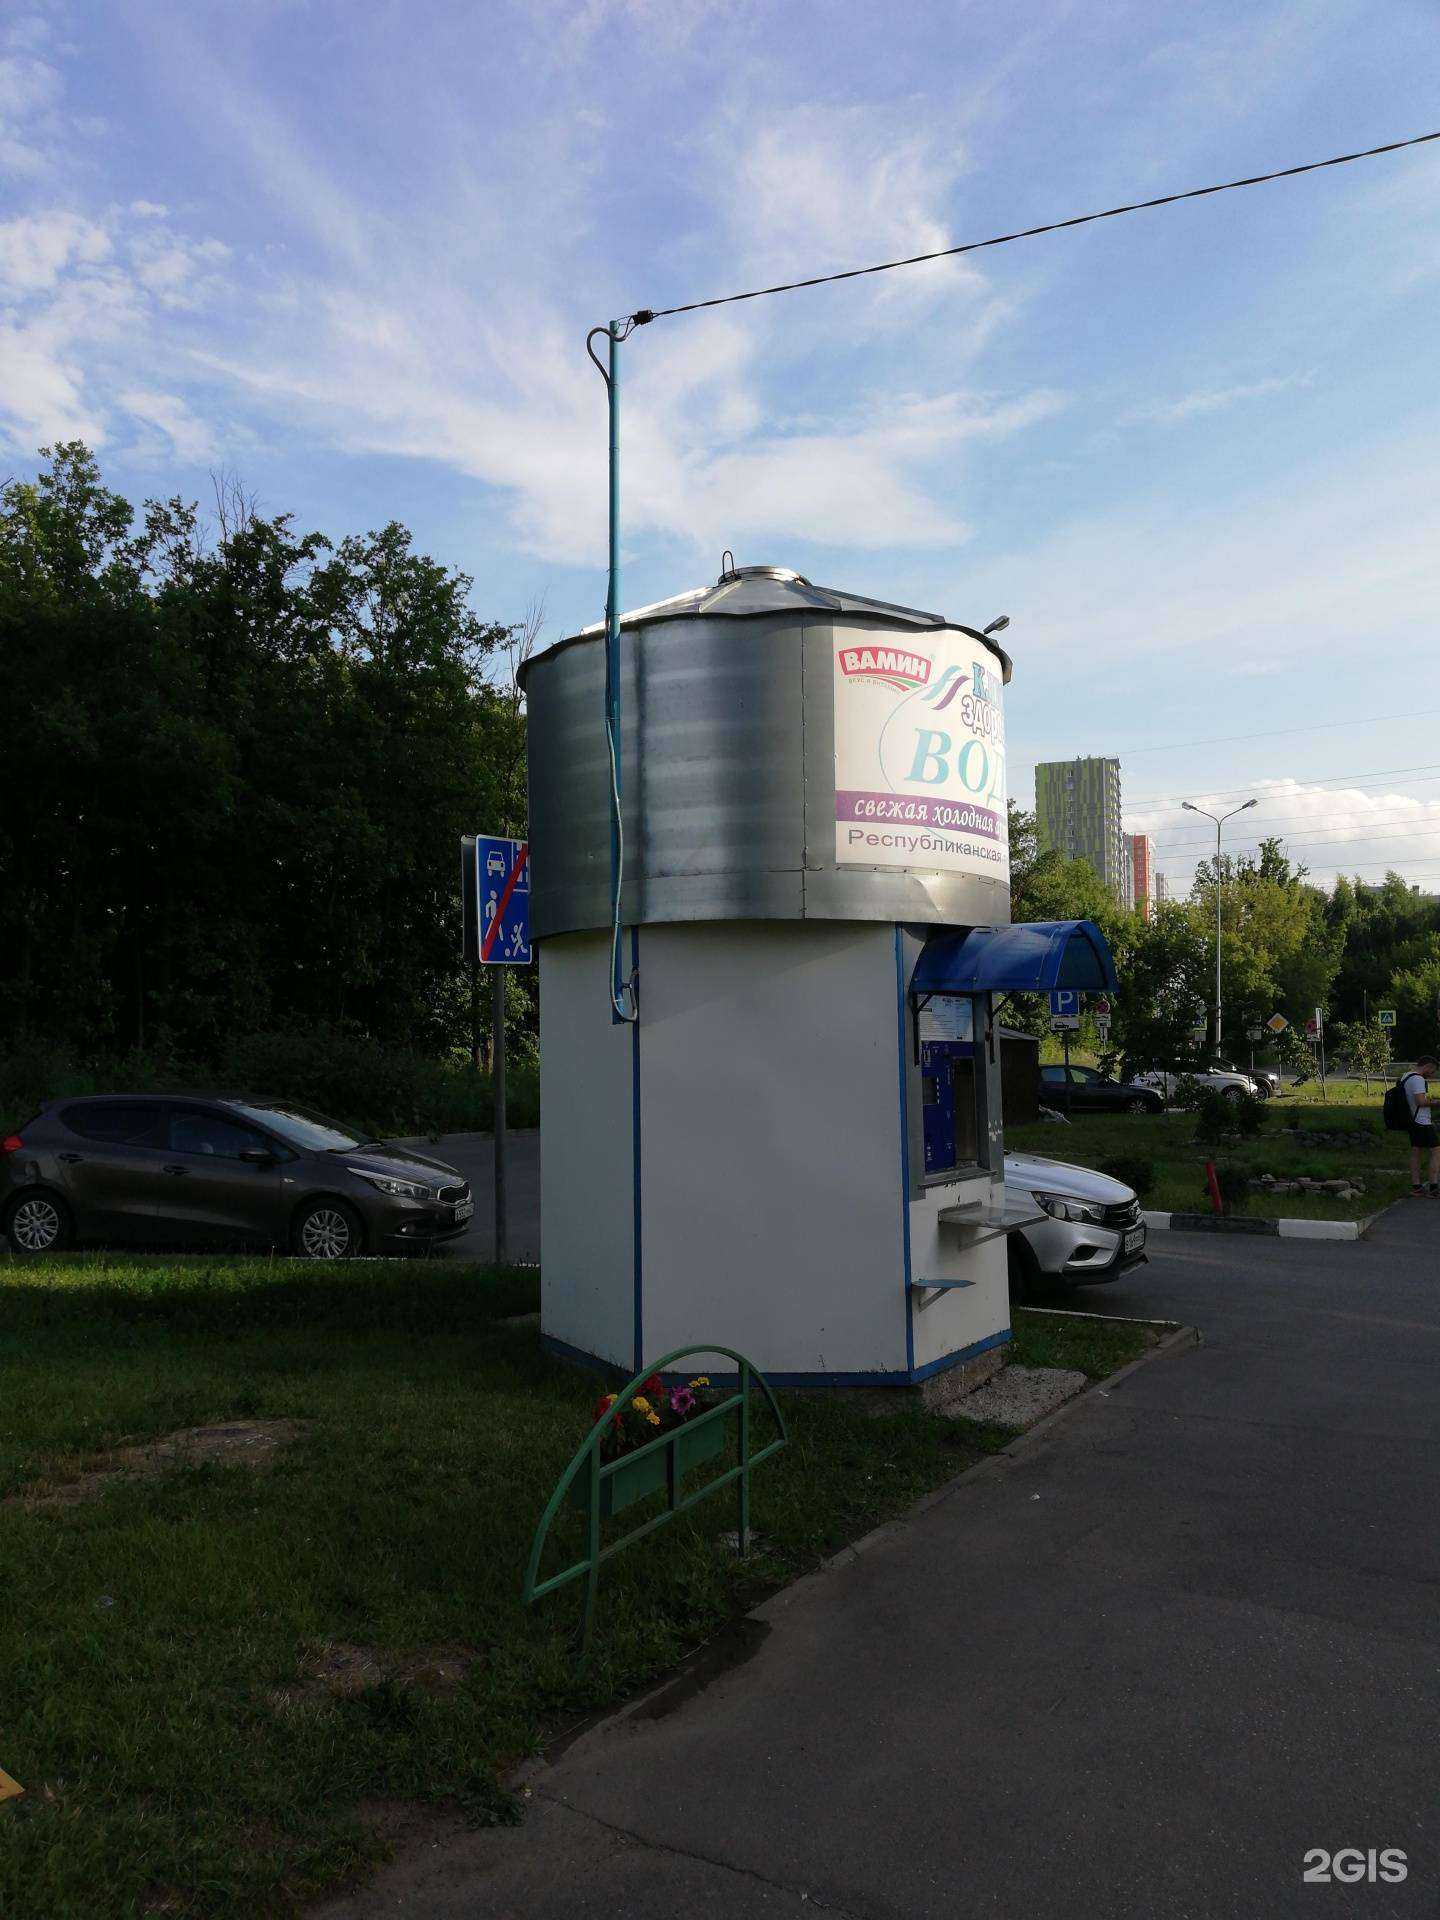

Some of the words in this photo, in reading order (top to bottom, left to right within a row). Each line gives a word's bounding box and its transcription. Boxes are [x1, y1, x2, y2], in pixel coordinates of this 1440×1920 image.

[843, 650, 928, 680] ВАМИН
[854, 798, 929, 821] свежая
[931, 804, 995, 834] холодная
[848, 827, 1002, 864] Республиканская
[1057, 991, 1074, 1012] P
